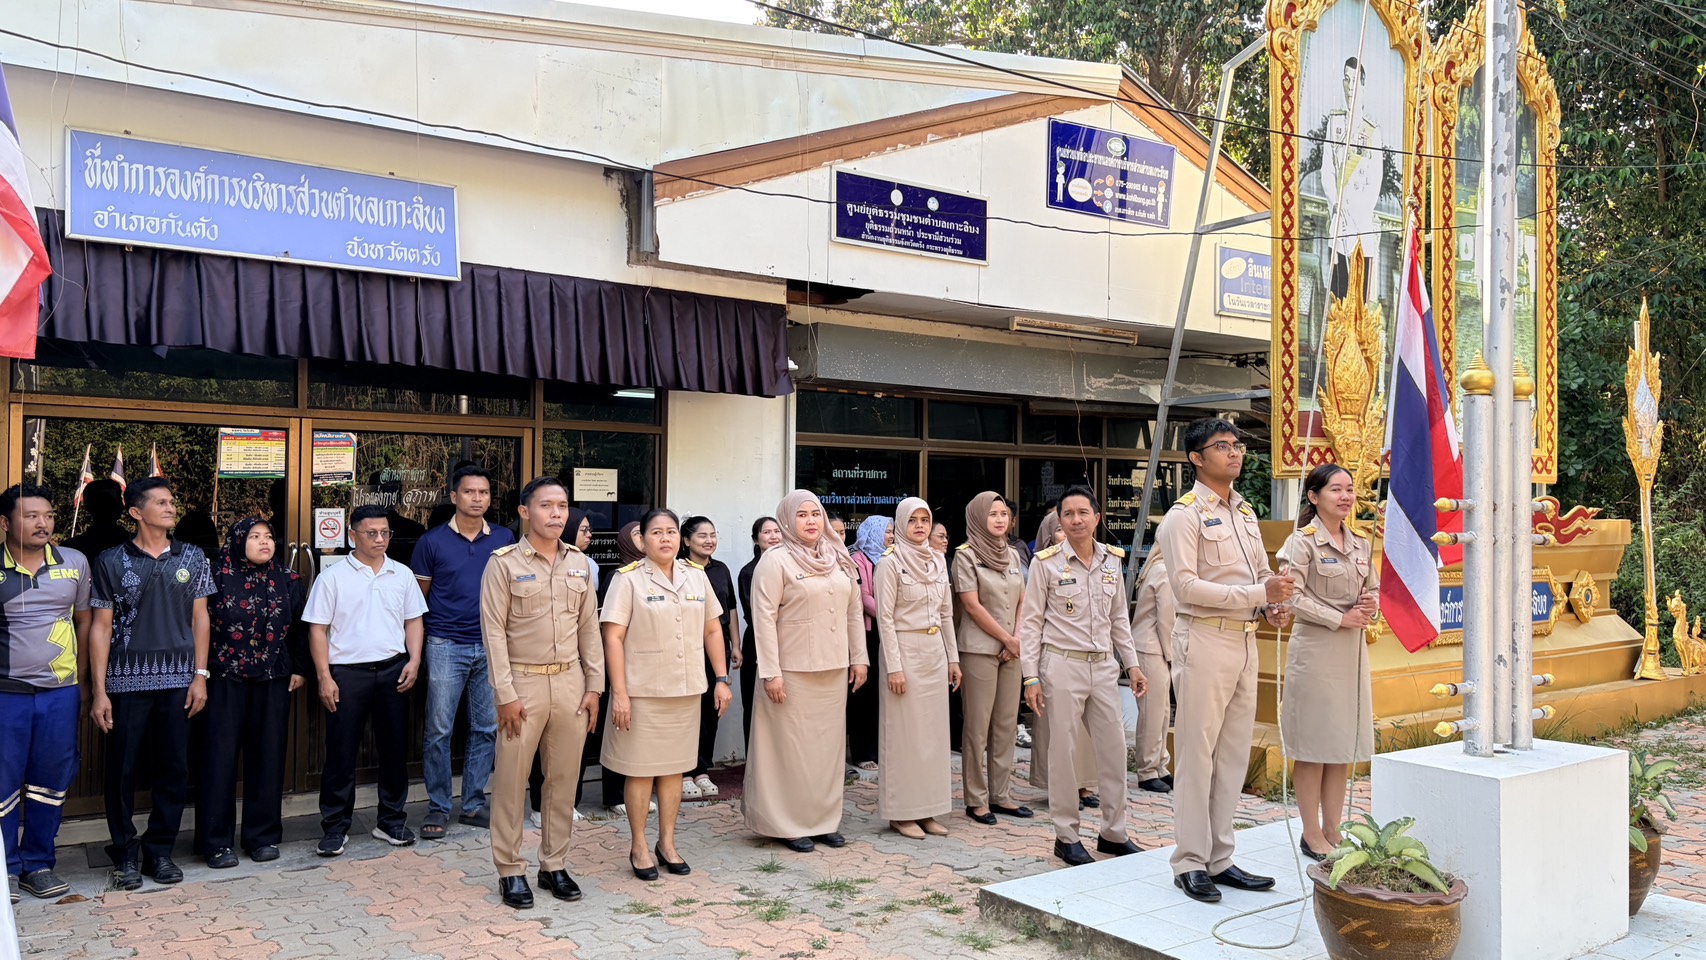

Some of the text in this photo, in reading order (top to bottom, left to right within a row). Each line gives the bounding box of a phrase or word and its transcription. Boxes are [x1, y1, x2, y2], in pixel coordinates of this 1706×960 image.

[84, 141, 446, 235] ที่ทำการองค์การบริหารส่วนตำบลเกาะลิบง
[846, 201, 980, 234] ศูนย์ยุติธรรมชุมชนตำบลเกาะลิบง
[93, 205, 441, 267] อำเภอกันตัง จังหวัดตรัง
[832, 463, 887, 479] สถานที่ราชการ
[403, 487, 440, 511] สุภาพ
[48, 568, 80, 580] EMS
